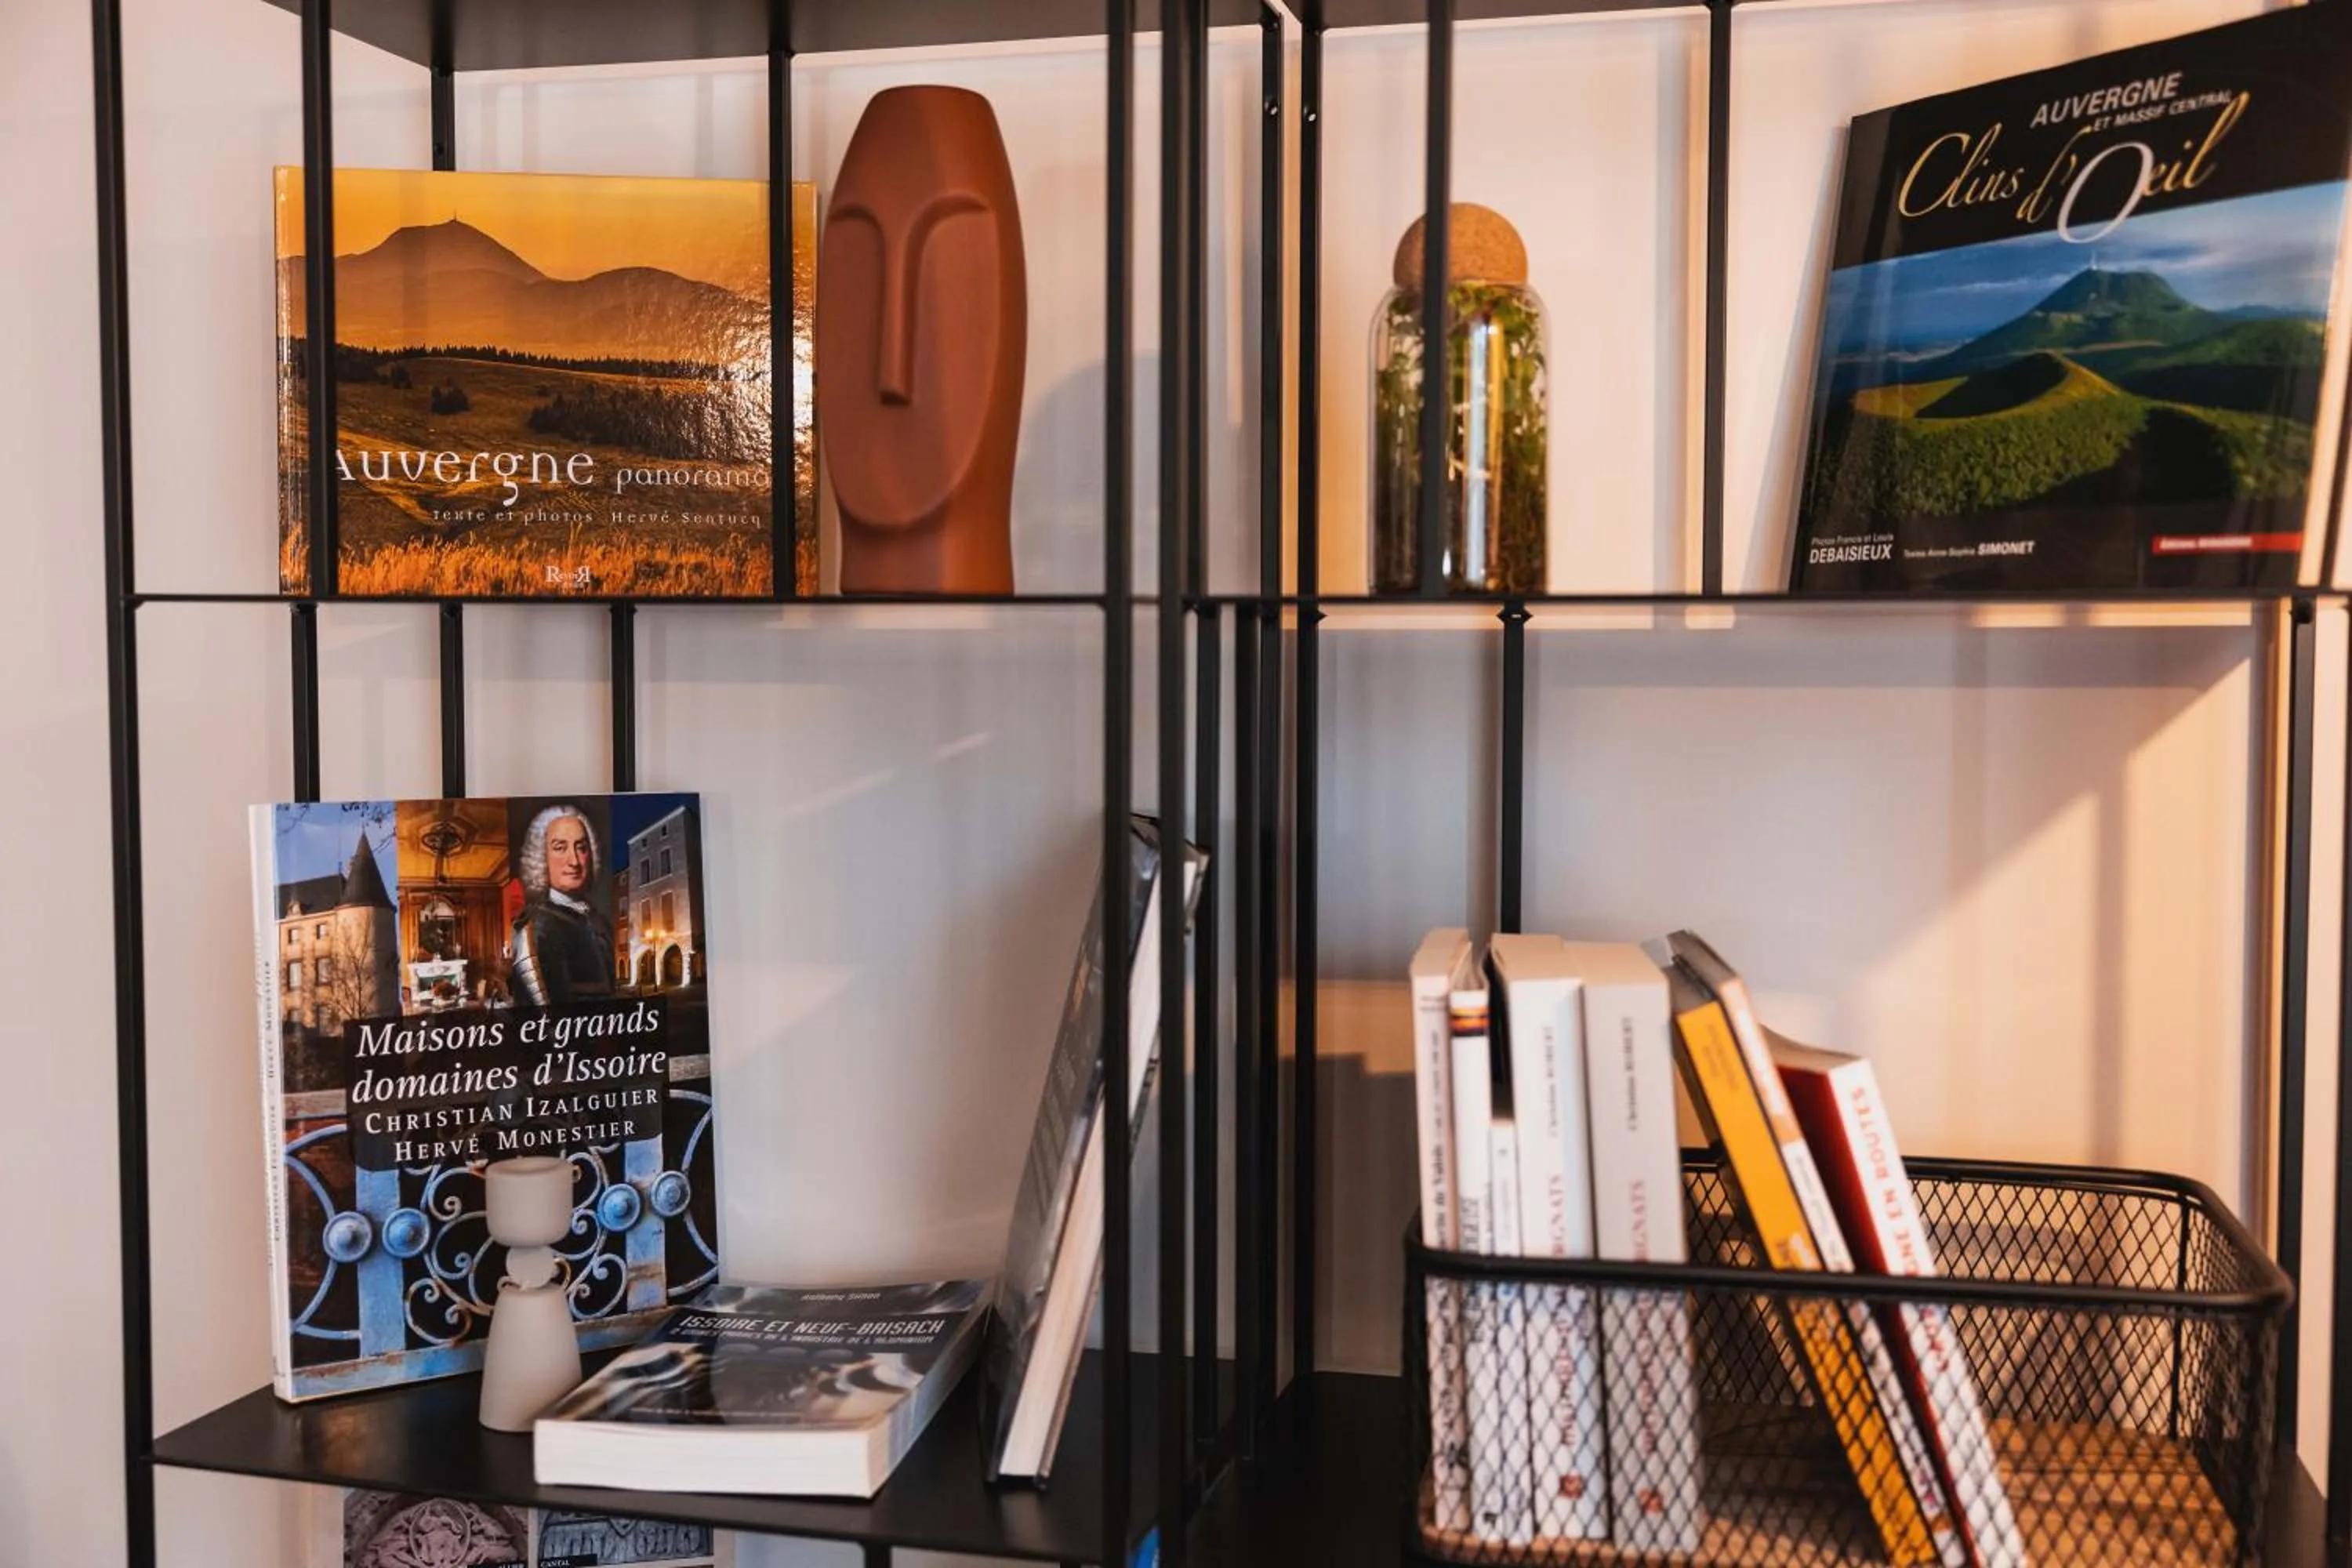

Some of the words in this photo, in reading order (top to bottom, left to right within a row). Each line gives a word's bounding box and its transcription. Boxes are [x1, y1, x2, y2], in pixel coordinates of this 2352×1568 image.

[2031, 72, 2183, 129] AUVERGNE
[2093, 117, 2112, 132] ET
[2114, 105, 2165, 127] MASSIF
[2169, 89, 2232, 115] CENTRAL
[1898, 122, 2023, 217] Clins
[524, 510, 593, 525] photos
[1809, 543, 1893, 564] DEBAISIEUX
[1977, 539, 2035, 556] SIMONET
[354, 1022, 504, 1059] Maisons
[519, 1016, 550, 1044] et
[554, 1003, 660, 1045] grands
[351, 1065, 518, 1105] domaines
[533, 1047, 666, 1087] d'Issoire
[365, 1102, 514, 1135] CHRISTIAN
[526, 1089, 659, 1118] IZALGUIER
[1851, 1085, 1890, 1179] ROUTES
[395, 1133, 480, 1163] HERVÉ
[498, 1120, 636, 1152] MONESTIER
[678, 1316, 764, 1330] ISSOIRE
[763, 1320, 794, 1333] ET
[793, 1319, 946, 1335] NEUF-BRISACH
